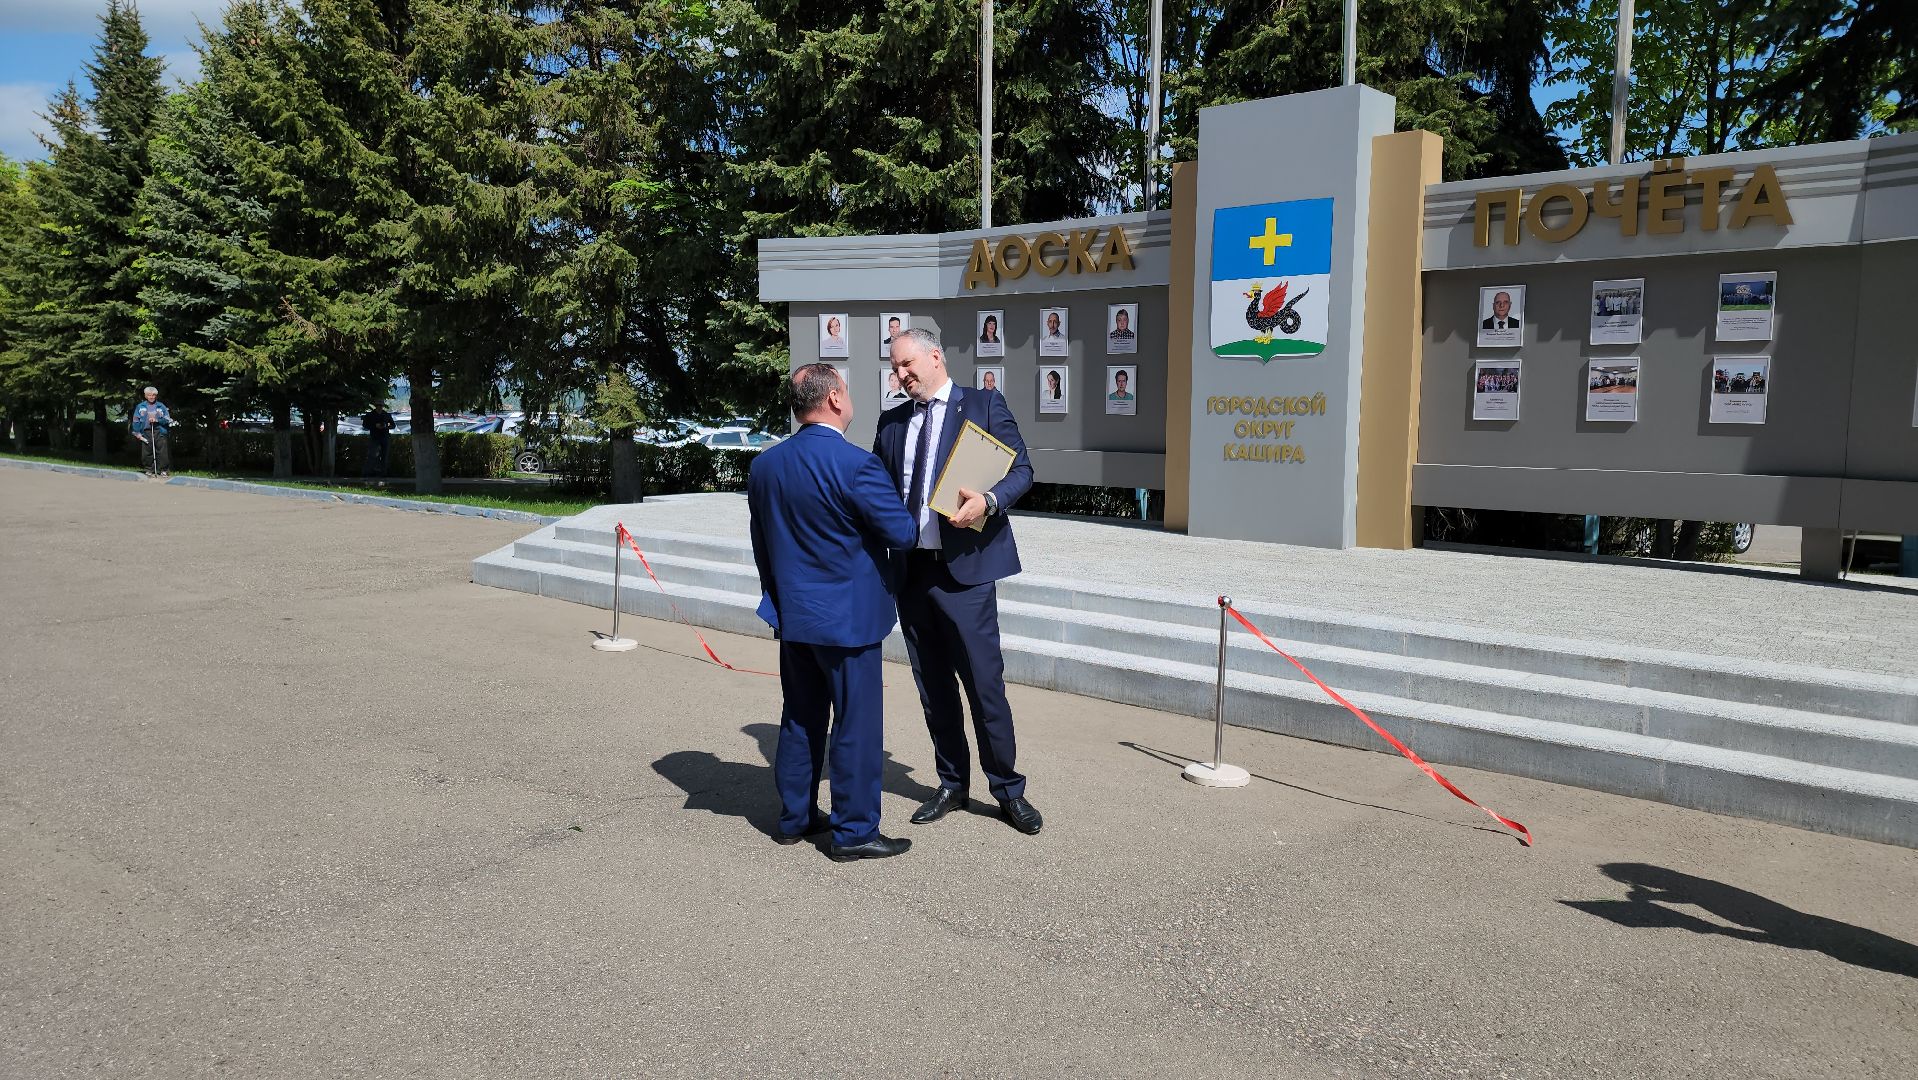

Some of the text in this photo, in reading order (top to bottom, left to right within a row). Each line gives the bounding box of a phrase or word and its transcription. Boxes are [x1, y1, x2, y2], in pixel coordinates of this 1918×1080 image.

[965, 157, 1794, 290] ДОСКА ПОЧЁТА
[1206, 391, 1327, 418] ГОРОДСКОЙ
[1234, 419, 1296, 439] ОКРУГ
[1223, 441, 1306, 464] КАШИРА
